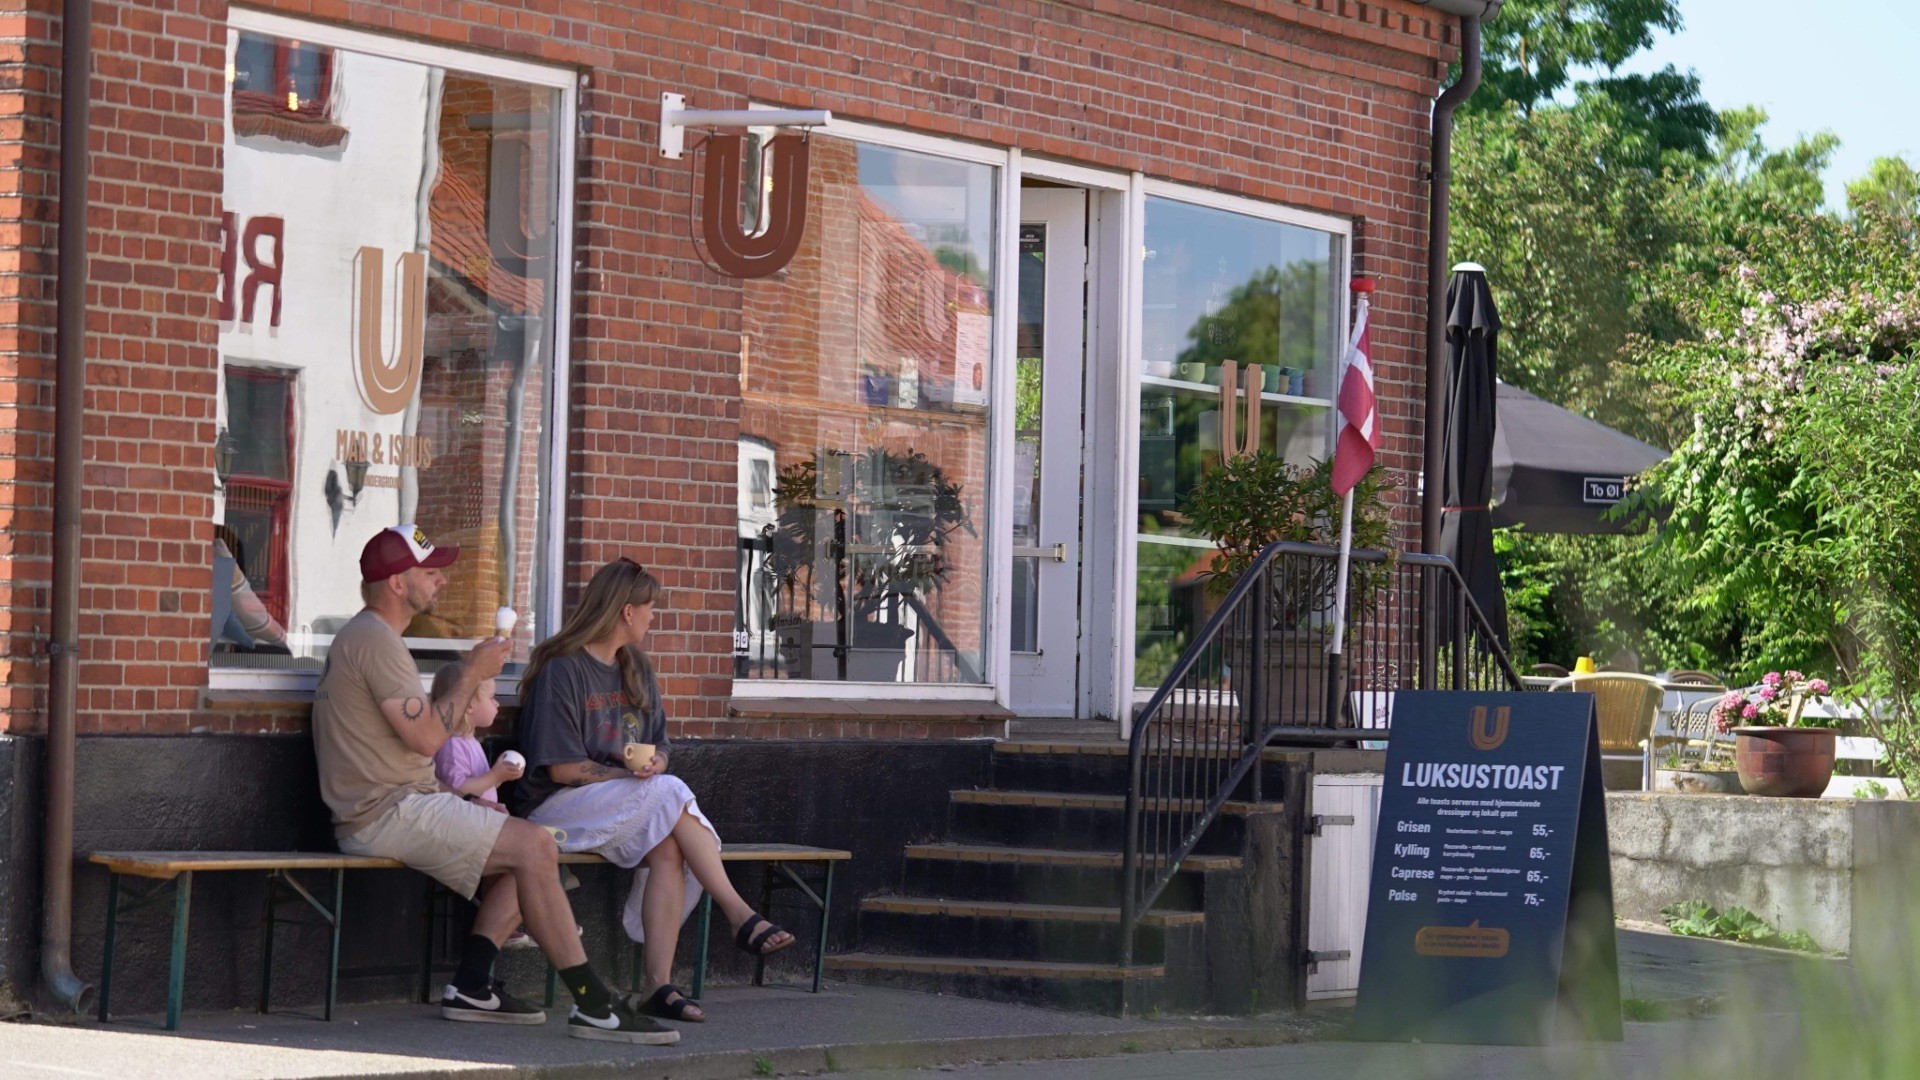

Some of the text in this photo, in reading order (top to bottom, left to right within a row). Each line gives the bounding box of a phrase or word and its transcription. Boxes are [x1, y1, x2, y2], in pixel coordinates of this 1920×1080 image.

[691, 136, 809, 278] U
[351, 246, 425, 415] U
[336, 429, 432, 468] MAD & ISHUS
[1590, 484, 1619, 498] To Øl
[1468, 705, 1511, 750] U
[1402, 762, 1565, 791] LUKSUSTOAST
[1417, 797, 1429, 805] Alle
[1430, 798, 1450, 806] toasts
[1495, 799, 1541, 809] hjemmelavede
[1437, 808, 1471, 818] dressinger
[1472, 810, 1480, 818] og
[1481, 809, 1499, 817] lokalt
[1397, 820, 1431, 833] Grisen
[1532, 824, 1554, 837] 55,-
[1394, 843, 1430, 859] Kylling
[1529, 847, 1551, 860] 65,-
[1391, 866, 1435, 881] Caprese
[1526, 870, 1549, 883] 65,-
[1388, 889, 1417, 902] Pølse
[1524, 893, 1545, 906] 75,-
